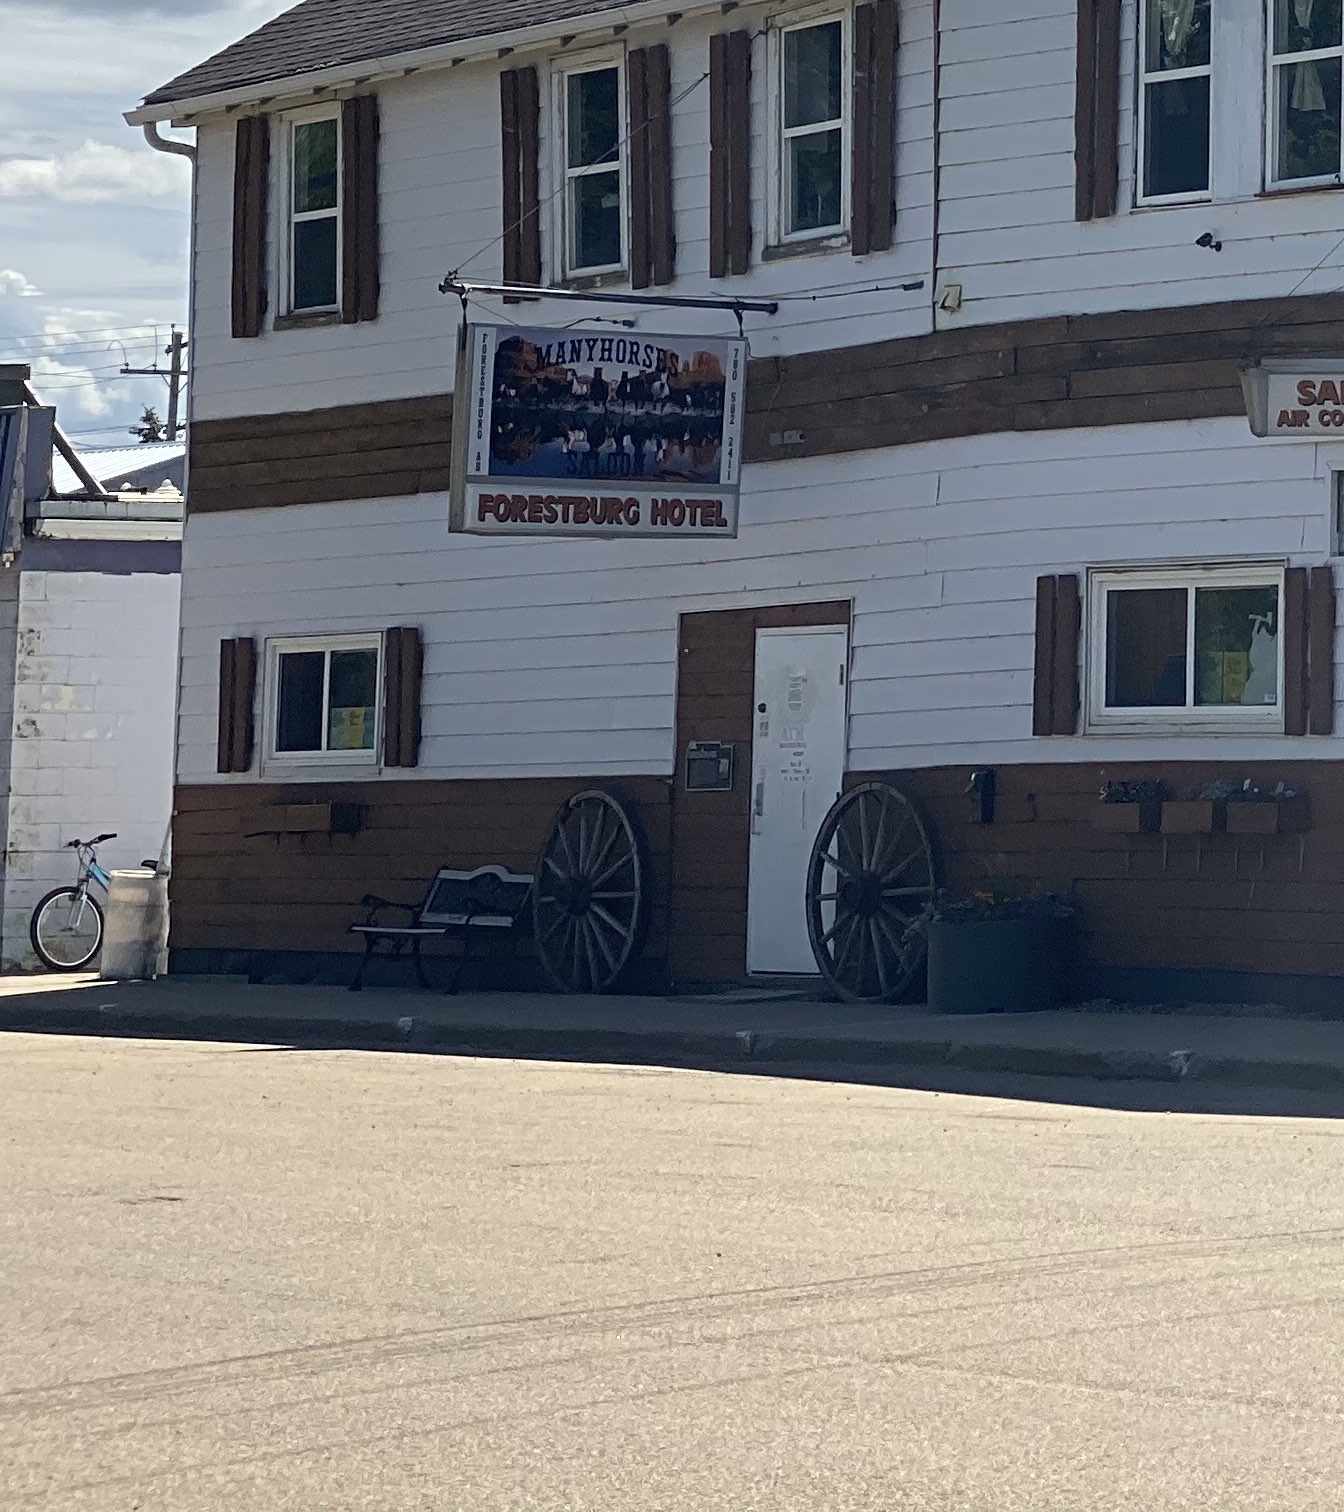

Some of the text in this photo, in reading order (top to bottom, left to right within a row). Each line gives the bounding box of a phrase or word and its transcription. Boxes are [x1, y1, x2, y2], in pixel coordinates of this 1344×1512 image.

[535, 338, 680, 377] MANYHORSES
[1276, 409, 1310, 428] AIR
[478, 493, 728, 528] FORESTBURG HOTEL
